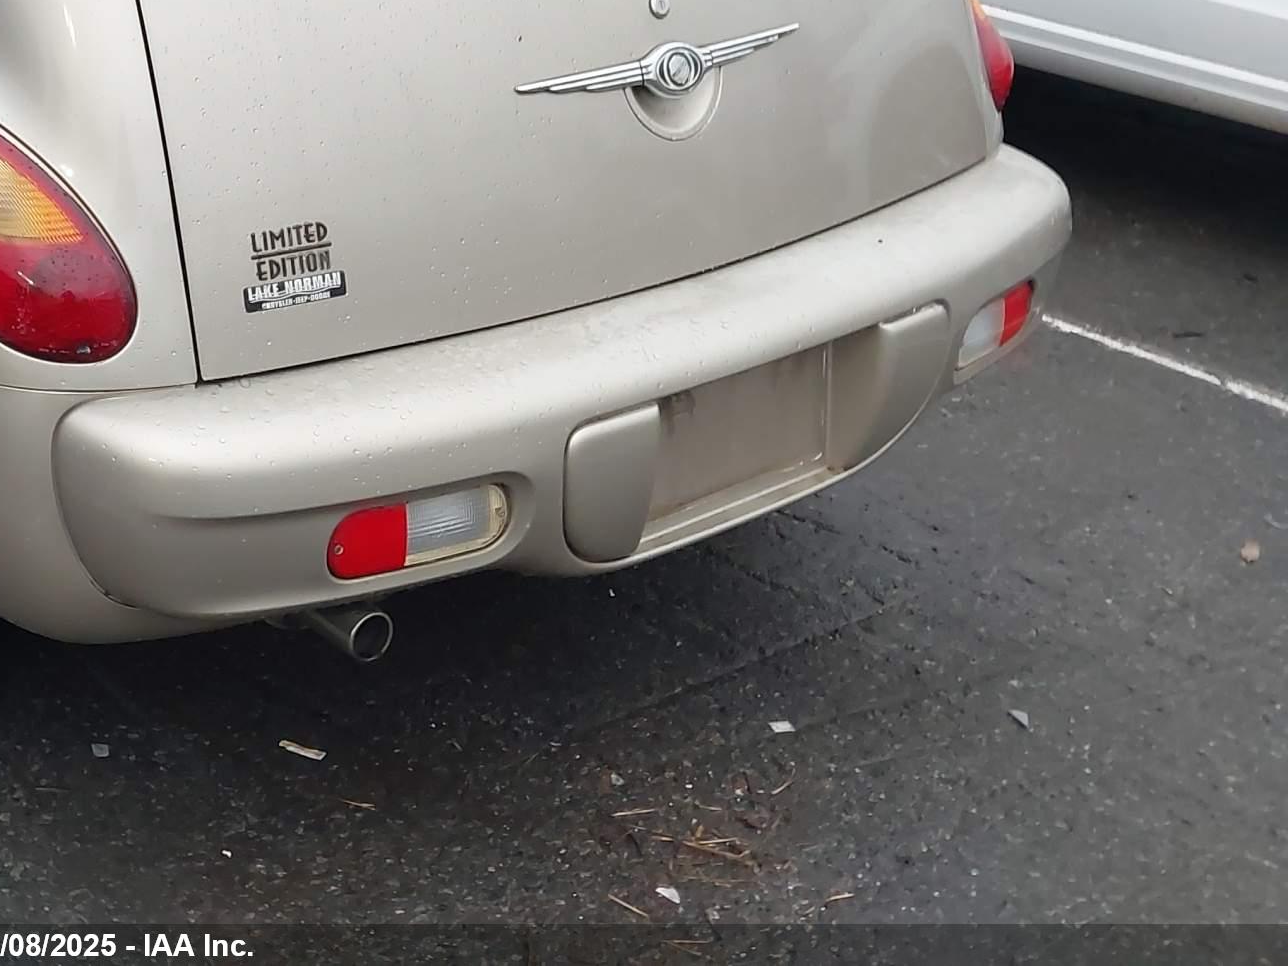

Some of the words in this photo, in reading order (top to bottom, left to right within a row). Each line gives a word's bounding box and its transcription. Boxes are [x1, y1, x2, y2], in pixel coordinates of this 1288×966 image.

[250, 221, 328, 253] LIMITED
[255, 249, 332, 281] EDITION
[247, 282, 281, 302] LAKE
[284, 271, 342, 294] NORMAN
